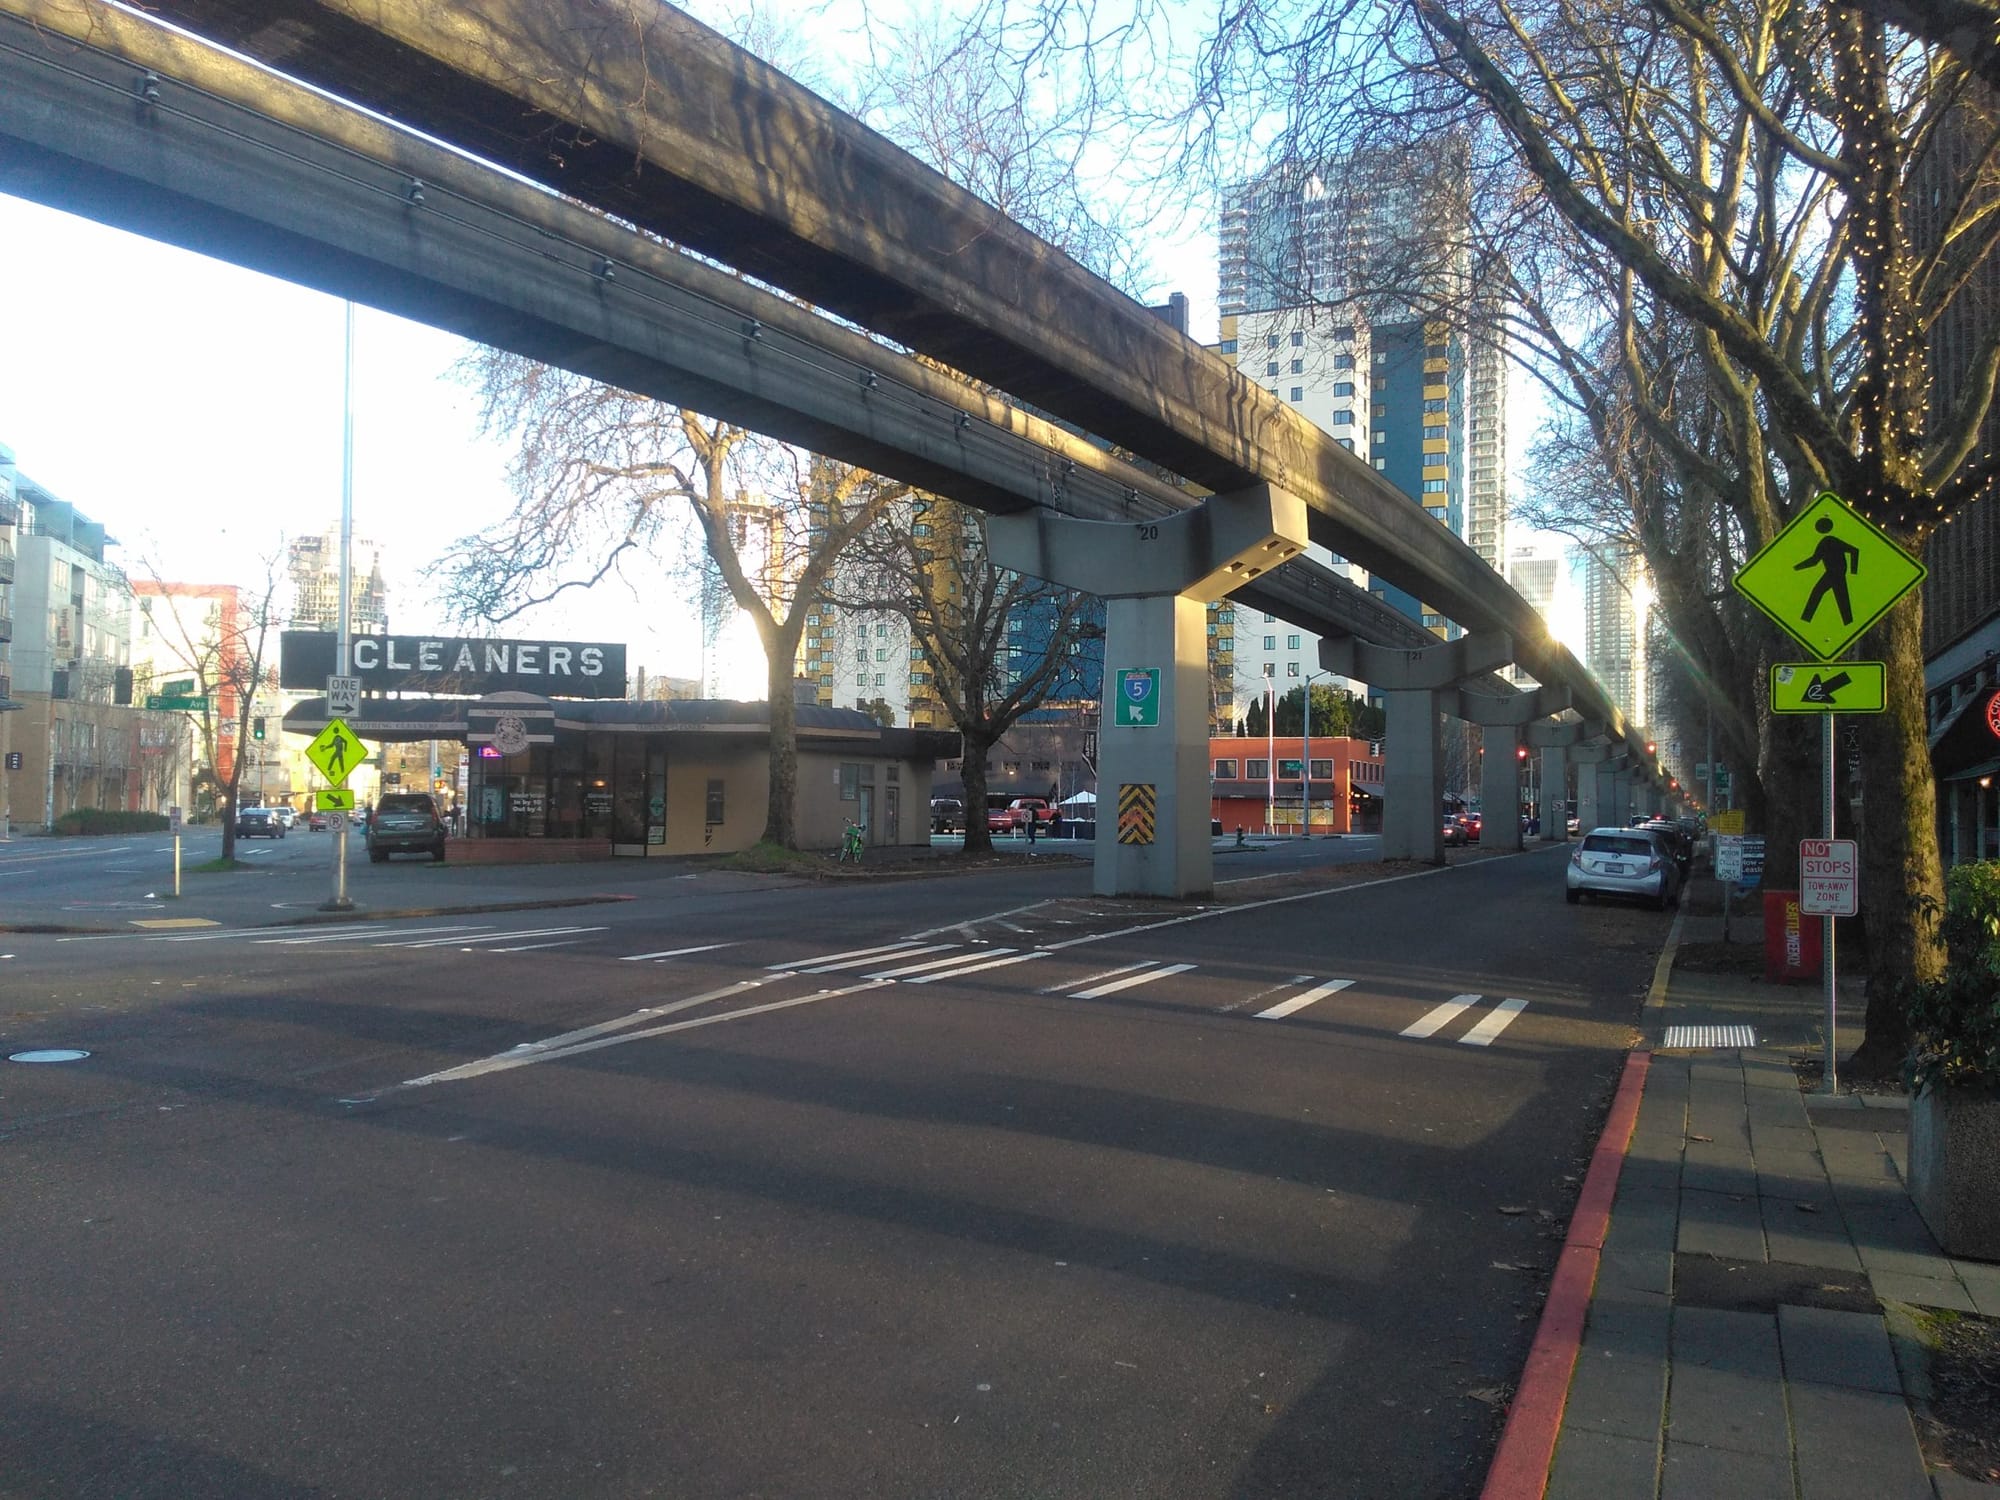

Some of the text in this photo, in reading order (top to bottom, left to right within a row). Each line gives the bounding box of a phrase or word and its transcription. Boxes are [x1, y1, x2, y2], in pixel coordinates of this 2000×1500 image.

[1140, 526, 1158, 540] 20
[354, 639, 604, 676] CLEANERS
[332, 679, 357, 691] ONE
[1133, 682, 1142, 696] 5
[331, 691, 357, 702] WAY
[190, 700, 206, 709] Ave
[1804, 842, 1826, 856] NO
[1806, 860, 1851, 874] STOPS
[1808, 881, 1849, 891] TOW-AWAY
[1816, 892, 1840, 902] ZONE
